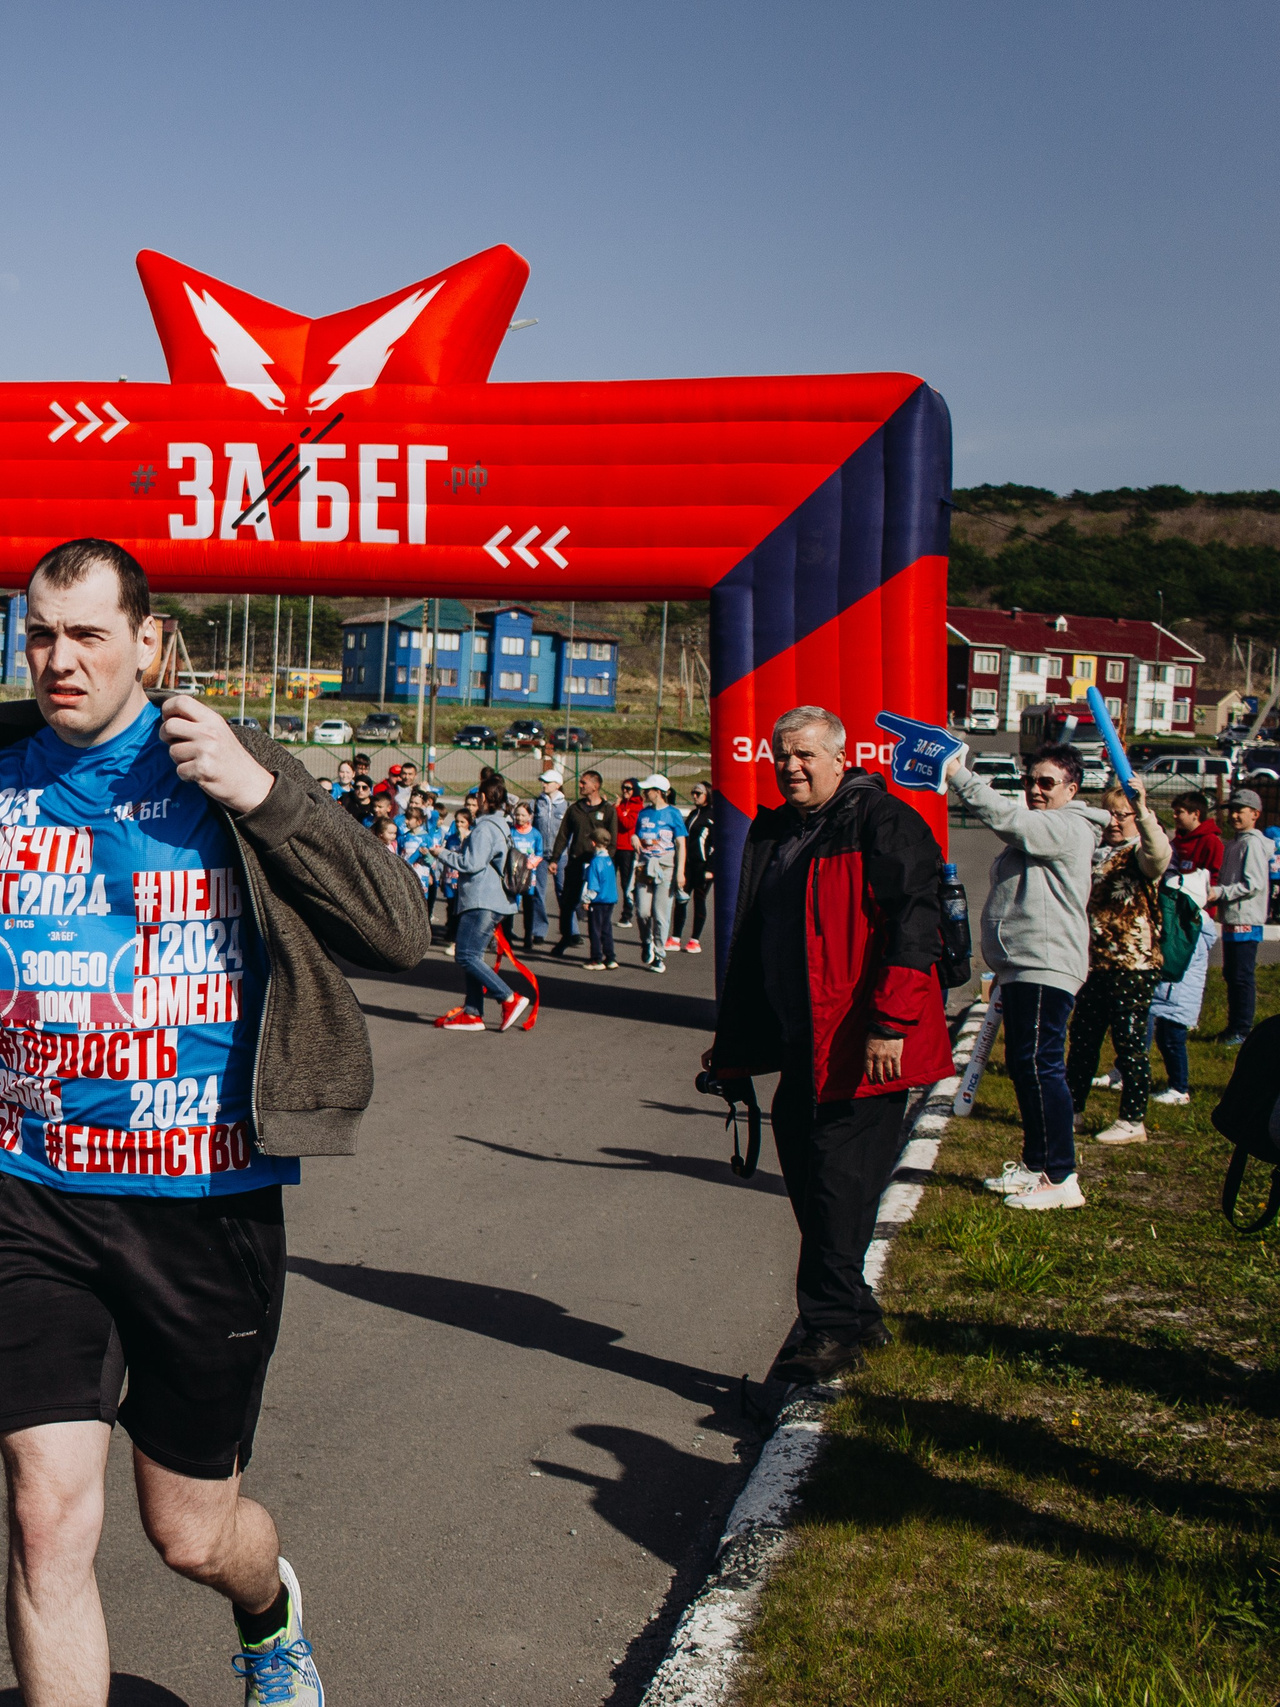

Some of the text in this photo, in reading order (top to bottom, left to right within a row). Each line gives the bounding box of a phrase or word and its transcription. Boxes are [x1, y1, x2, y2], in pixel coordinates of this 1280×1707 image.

[915, 764, 933, 776] ПСБ
[132, 868, 243, 924] #ЦЕЛЬ
[16, 919, 35, 929] ПСБ
[21, 950, 108, 988] 30050
[35, 990, 92, 1024] 10КМ
[133, 970, 244, 1030] ОМЕНТ
[967, 1073, 979, 1092] ПСБ
[129, 1074, 220, 1131] 2024
[43, 1121, 252, 1177] #ЕДИНСТВО
